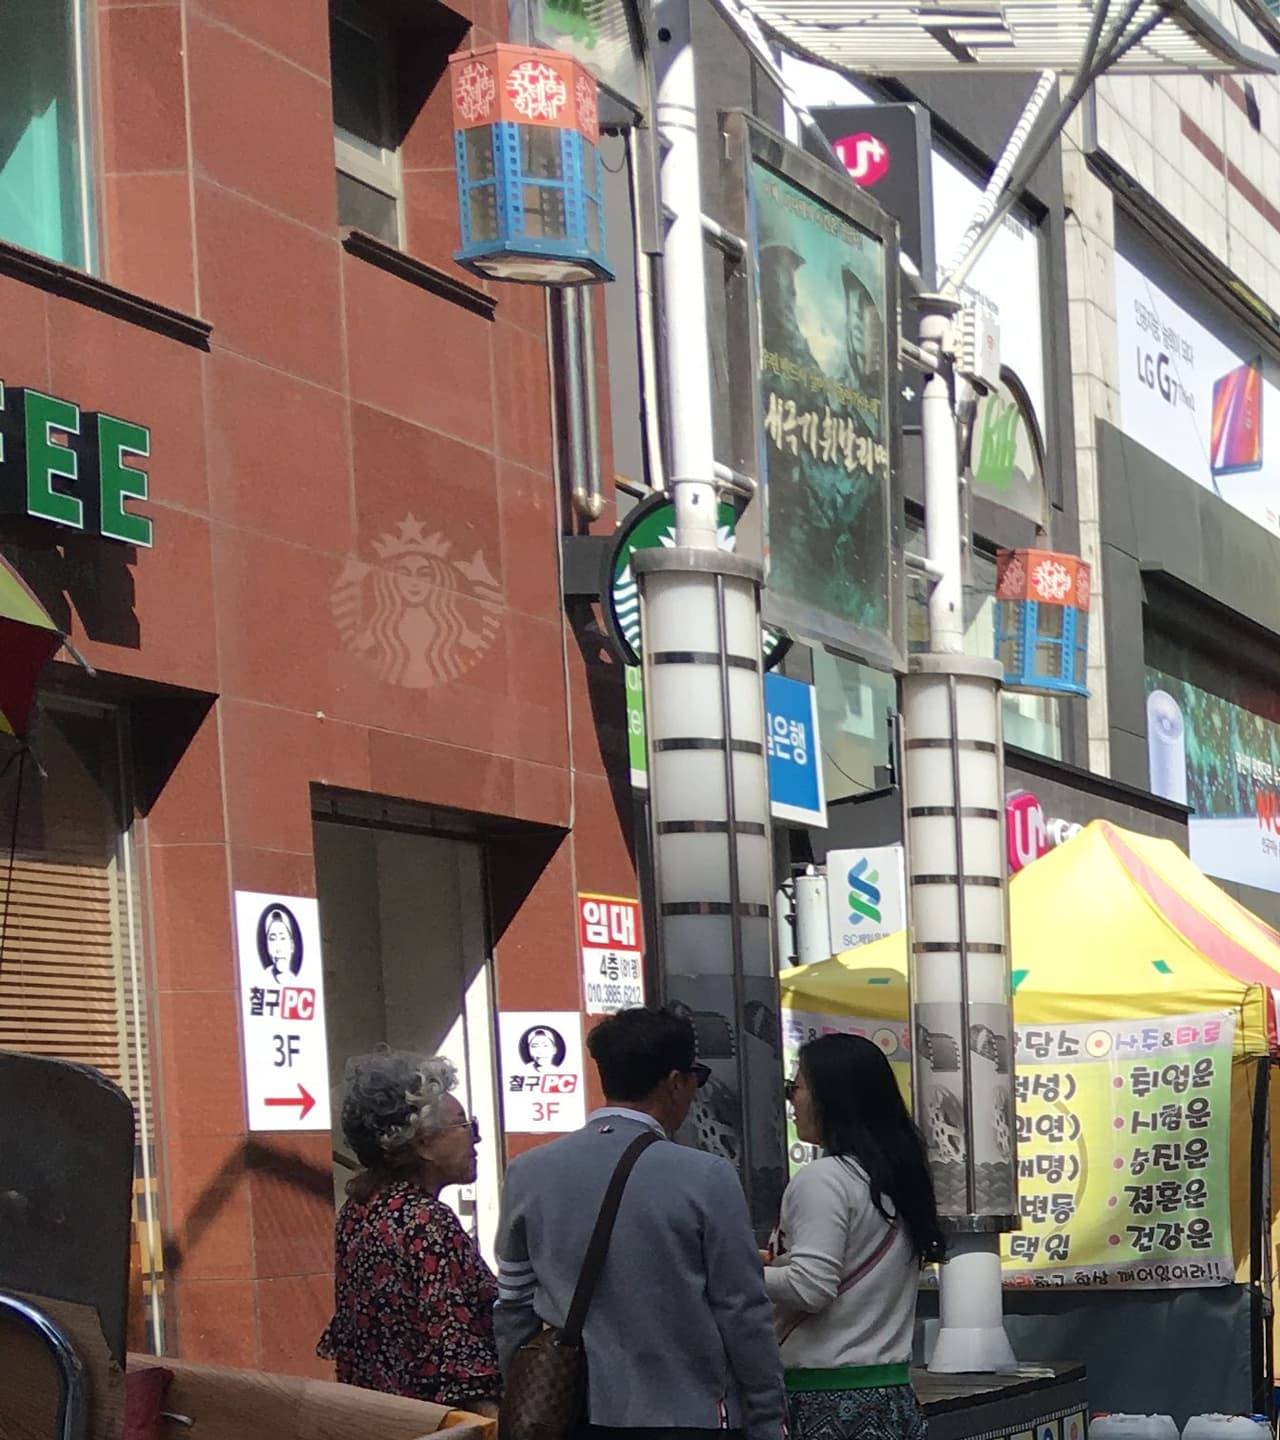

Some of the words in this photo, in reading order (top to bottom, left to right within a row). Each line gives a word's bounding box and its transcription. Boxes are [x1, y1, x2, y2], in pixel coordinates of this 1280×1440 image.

[1136, 345, 1155, 391] LG
[0, 380, 153, 548] EE
[583, 901, 637, 947] 임대
[272, 1034, 301, 1067] 3F
[1130, 1057, 1215, 1097] 취업운
[531, 1102, 560, 1122] 3F
[1130, 1097, 1212, 1135] 시험운
[1129, 1137, 1210, 1176] 승진운
[1019, 1193, 1076, 1224] 변동
[1123, 1178, 1209, 1215] 결혼운
[1125, 1217, 1214, 1253] 건강운
[1074, 1271, 1109, 1287] 항상
